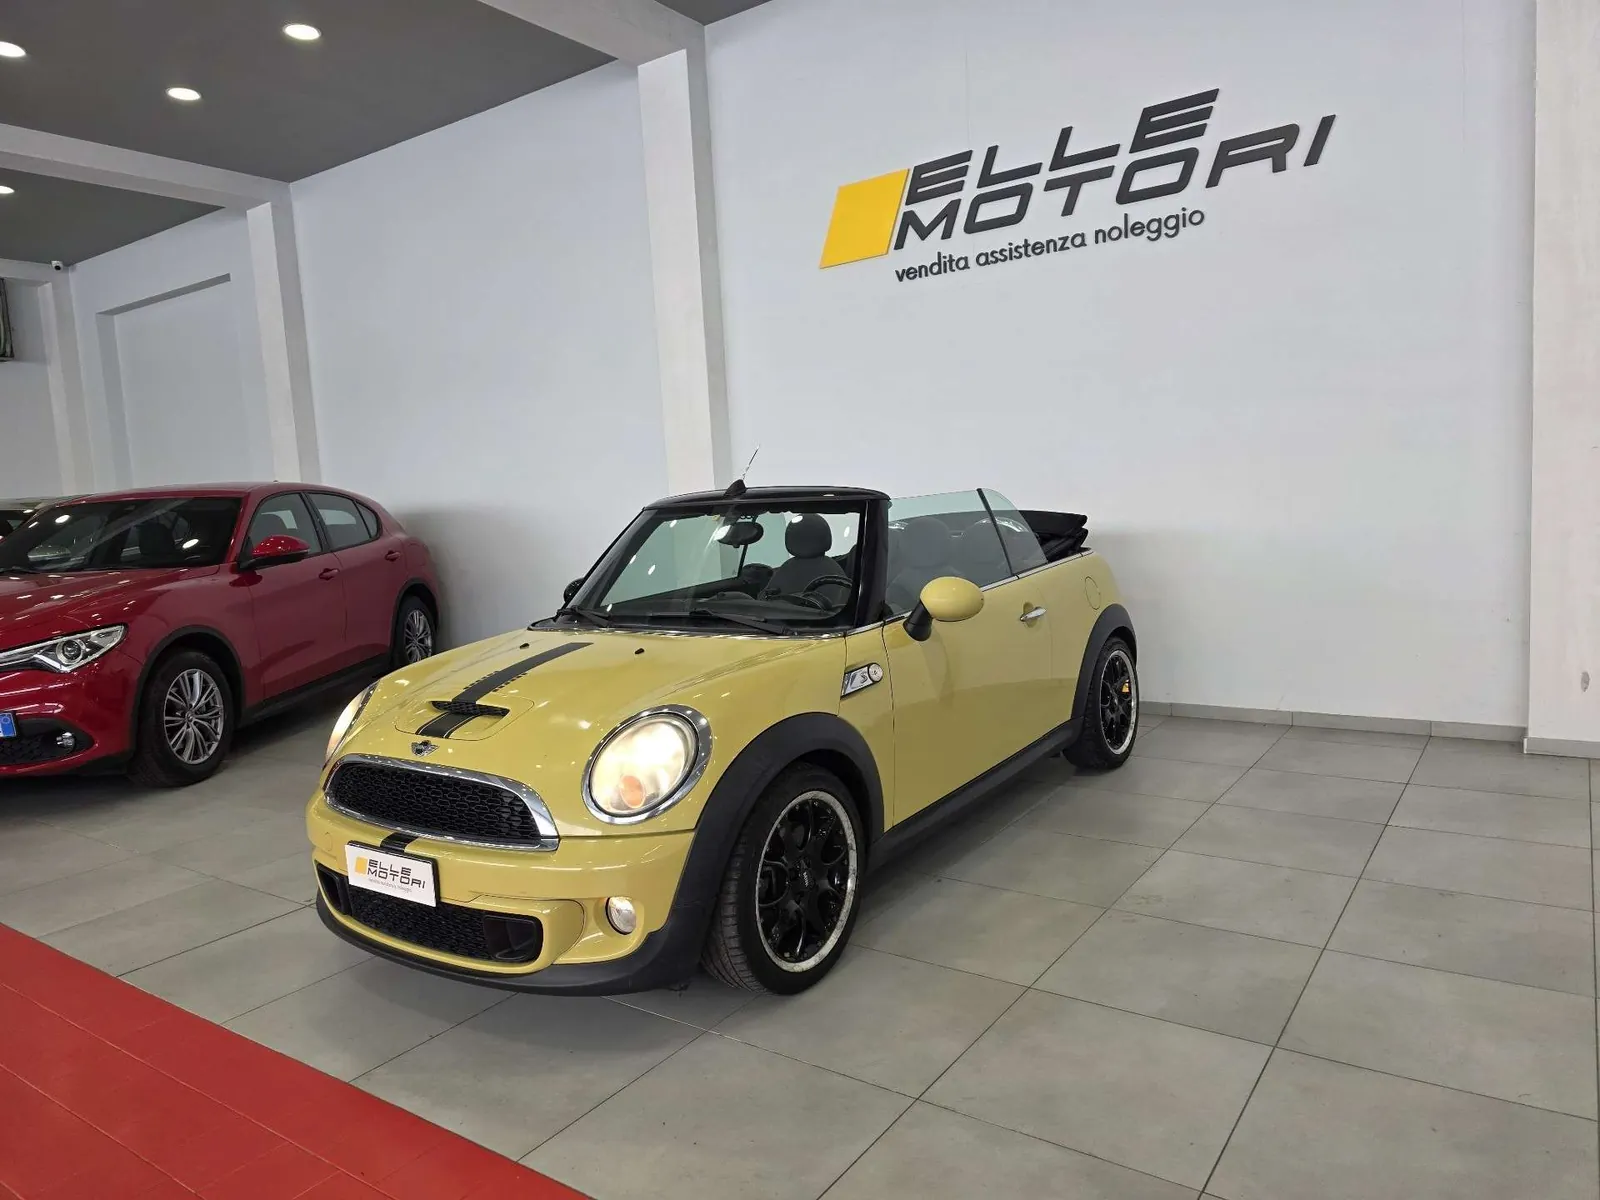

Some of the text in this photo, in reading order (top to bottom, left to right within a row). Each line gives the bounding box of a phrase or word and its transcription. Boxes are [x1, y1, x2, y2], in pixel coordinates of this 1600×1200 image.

[893, 114, 1337, 251] MOTORI
[904, 88, 1220, 206] ELLE
[894, 206, 1206, 283] vendita assistenza noleggio
[367, 867, 426, 889] MOTORI
[368, 859, 412, 877] ELLE
